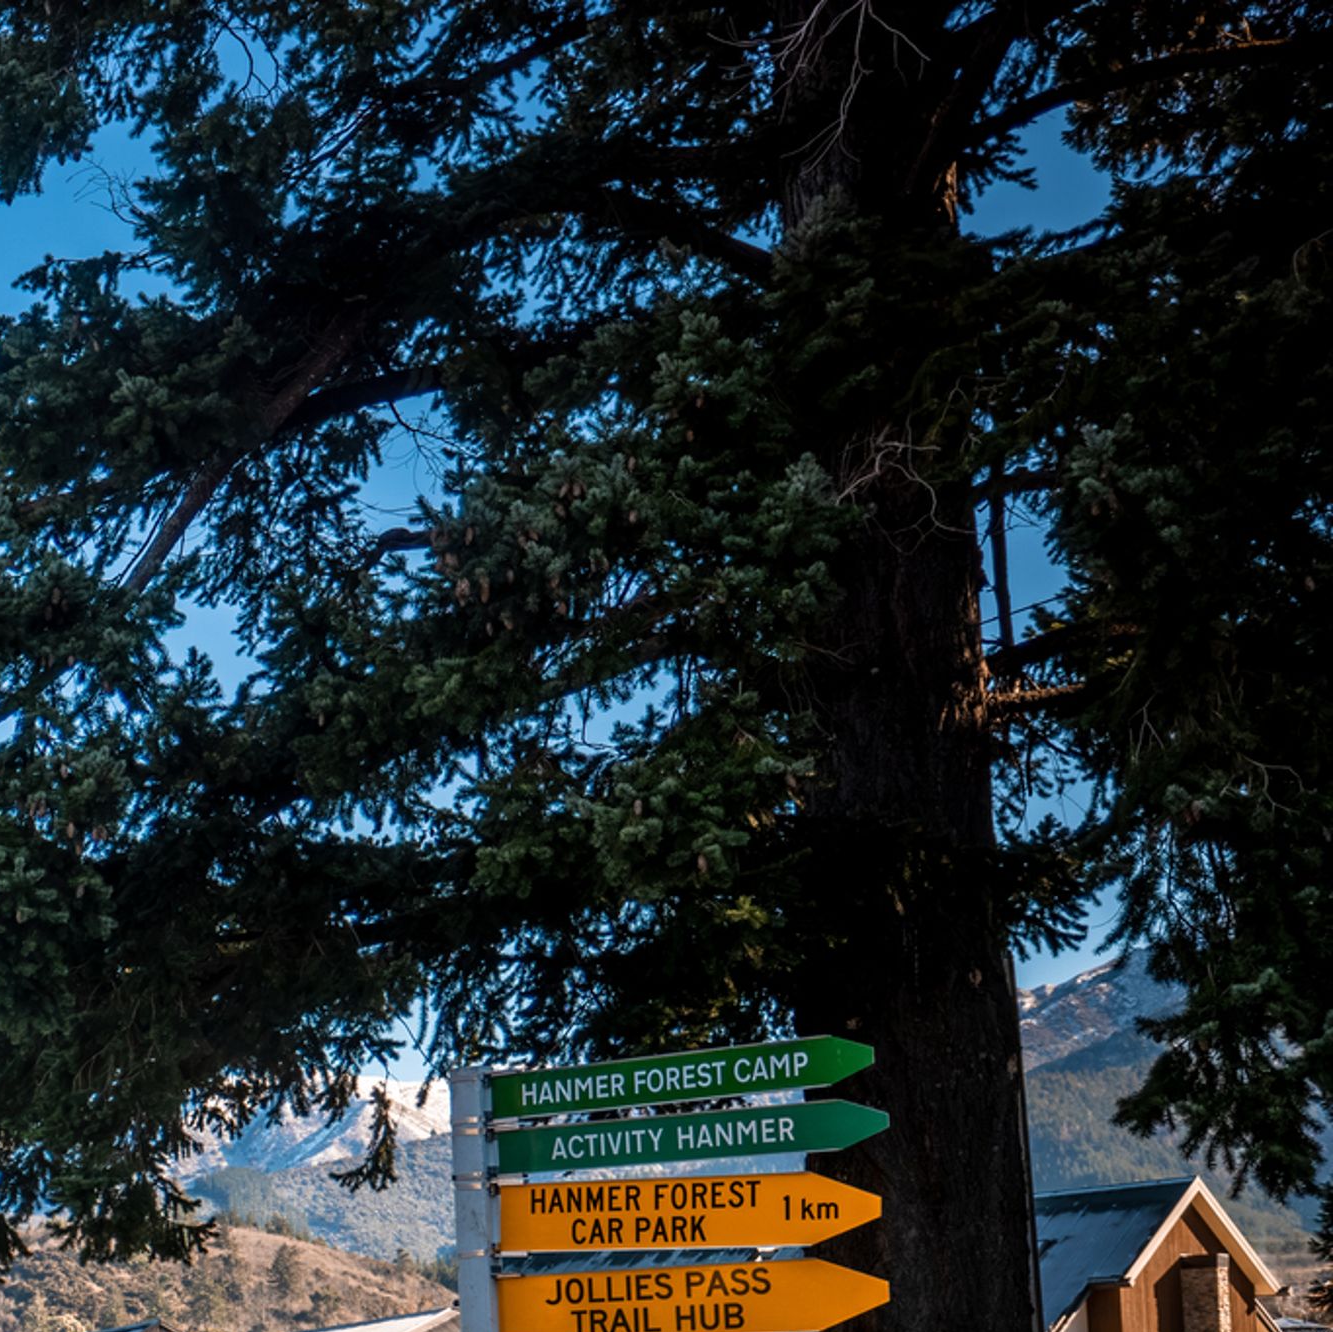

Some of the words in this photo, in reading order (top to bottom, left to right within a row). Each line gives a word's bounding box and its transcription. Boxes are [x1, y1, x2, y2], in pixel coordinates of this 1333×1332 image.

[521, 1073, 625, 1106] HANMER
[634, 1061, 726, 1095] FOREST
[733, 1052, 809, 1085] CAMP
[551, 1128, 663, 1160] ACTIVITY
[676, 1117, 795, 1150] HANMER
[529, 1184, 641, 1215] HANMER
[653, 1180, 762, 1210] FOREST
[783, 1195, 792, 1221] 1
[800, 1196, 840, 1220] km
[571, 1218, 623, 1245] CAR
[635, 1215, 707, 1243] PARK
[545, 1273, 674, 1305] JOLLIES
[685, 1268, 771, 1298] PASS
[675, 1304, 745, 1331] HUB
